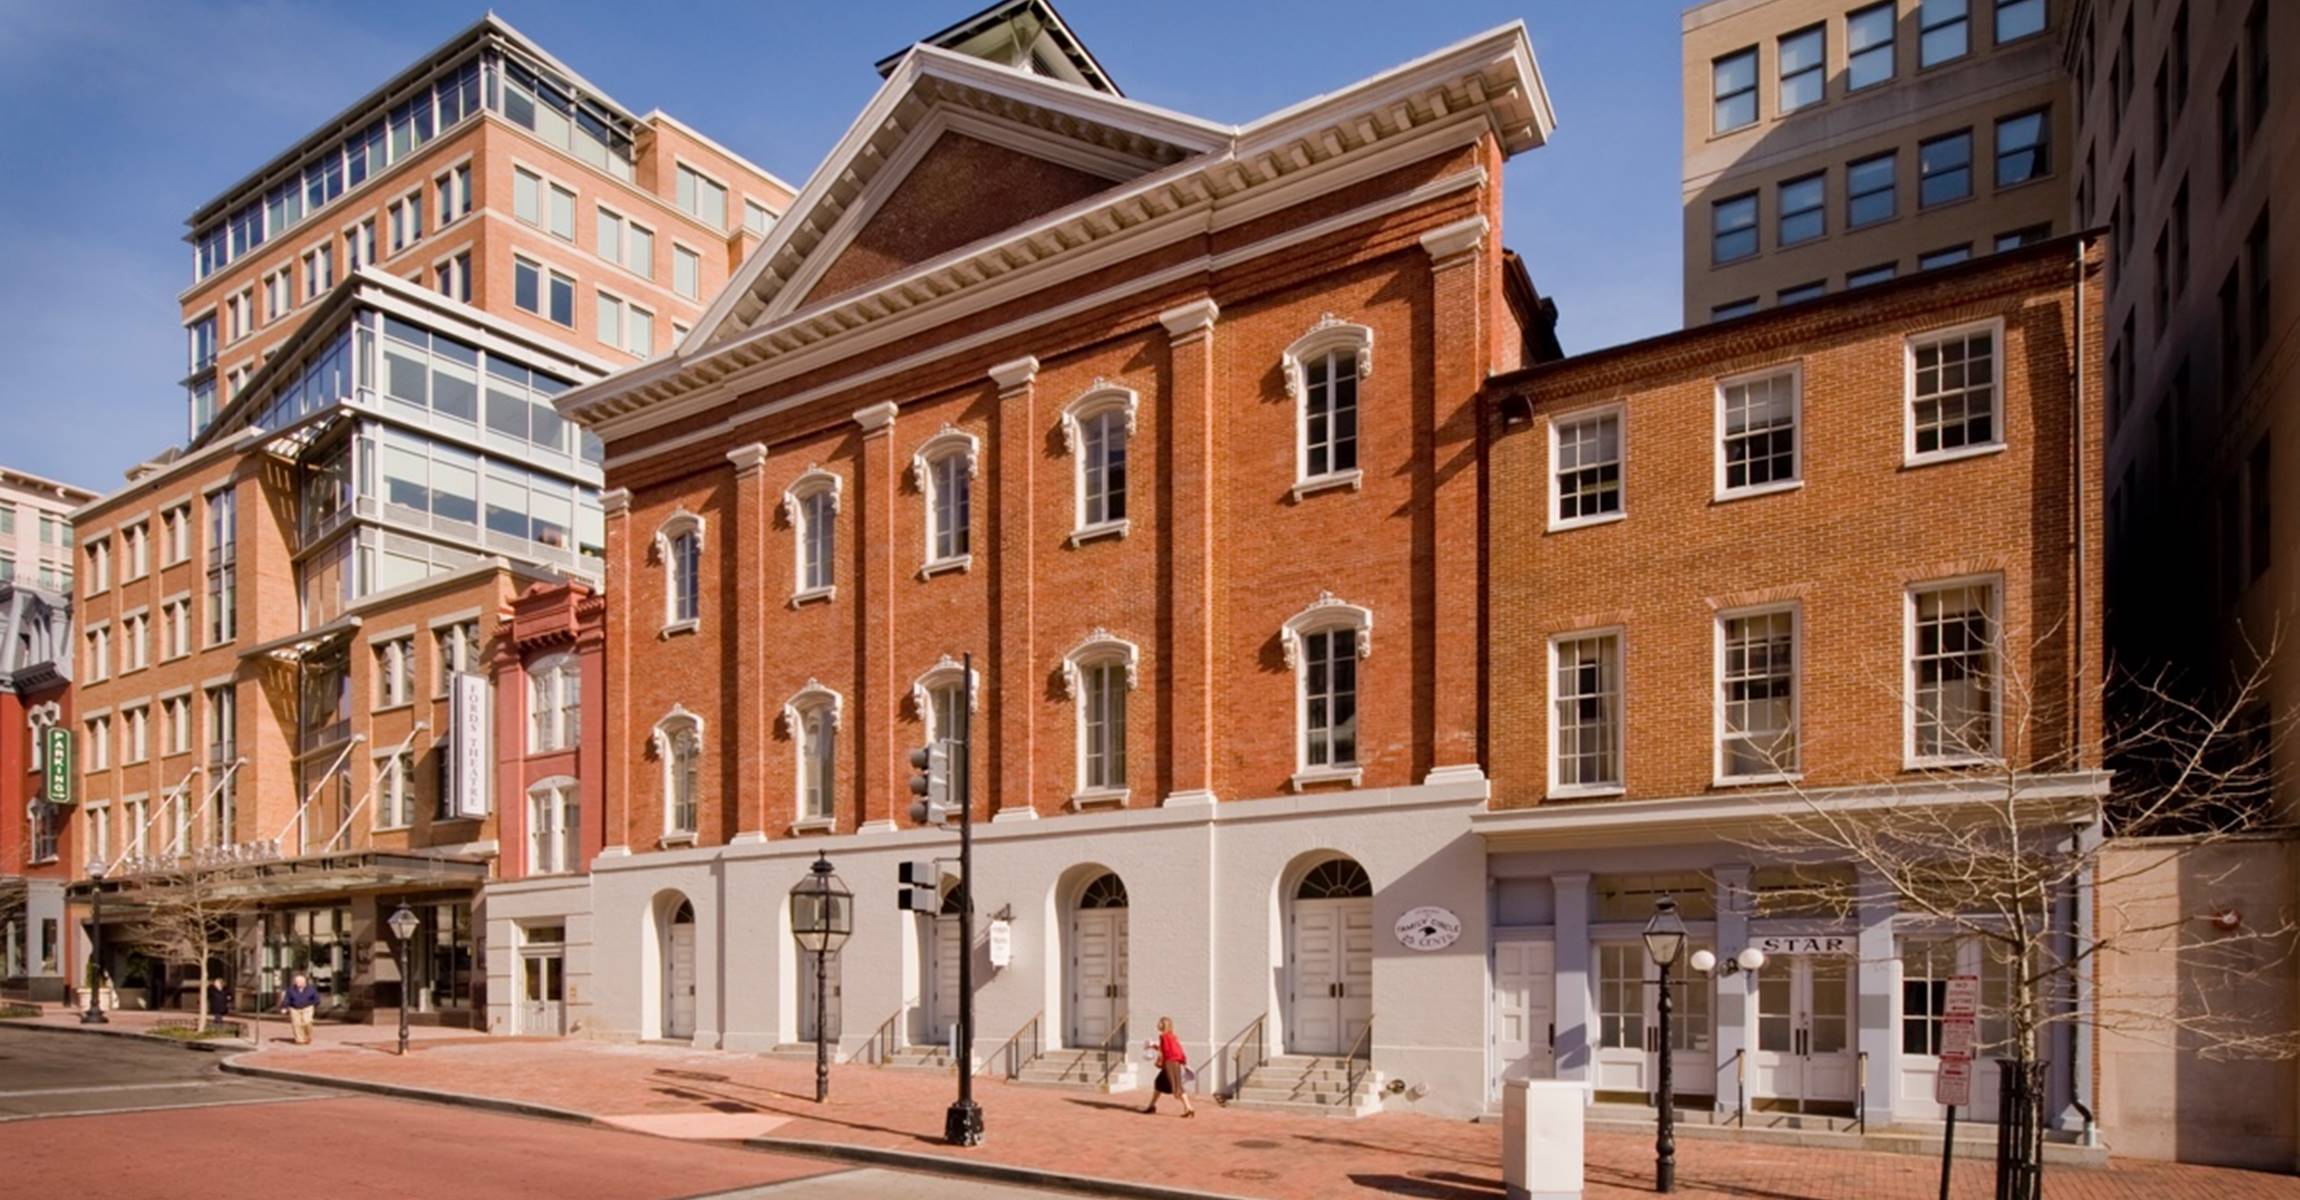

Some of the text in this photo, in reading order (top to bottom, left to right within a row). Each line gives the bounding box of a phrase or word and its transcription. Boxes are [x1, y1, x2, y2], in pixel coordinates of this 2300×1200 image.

[54, 732, 65, 792] PARKING
[1430, 918, 1459, 934] CIRCLE
[1762, 937, 1843, 953] STAR
